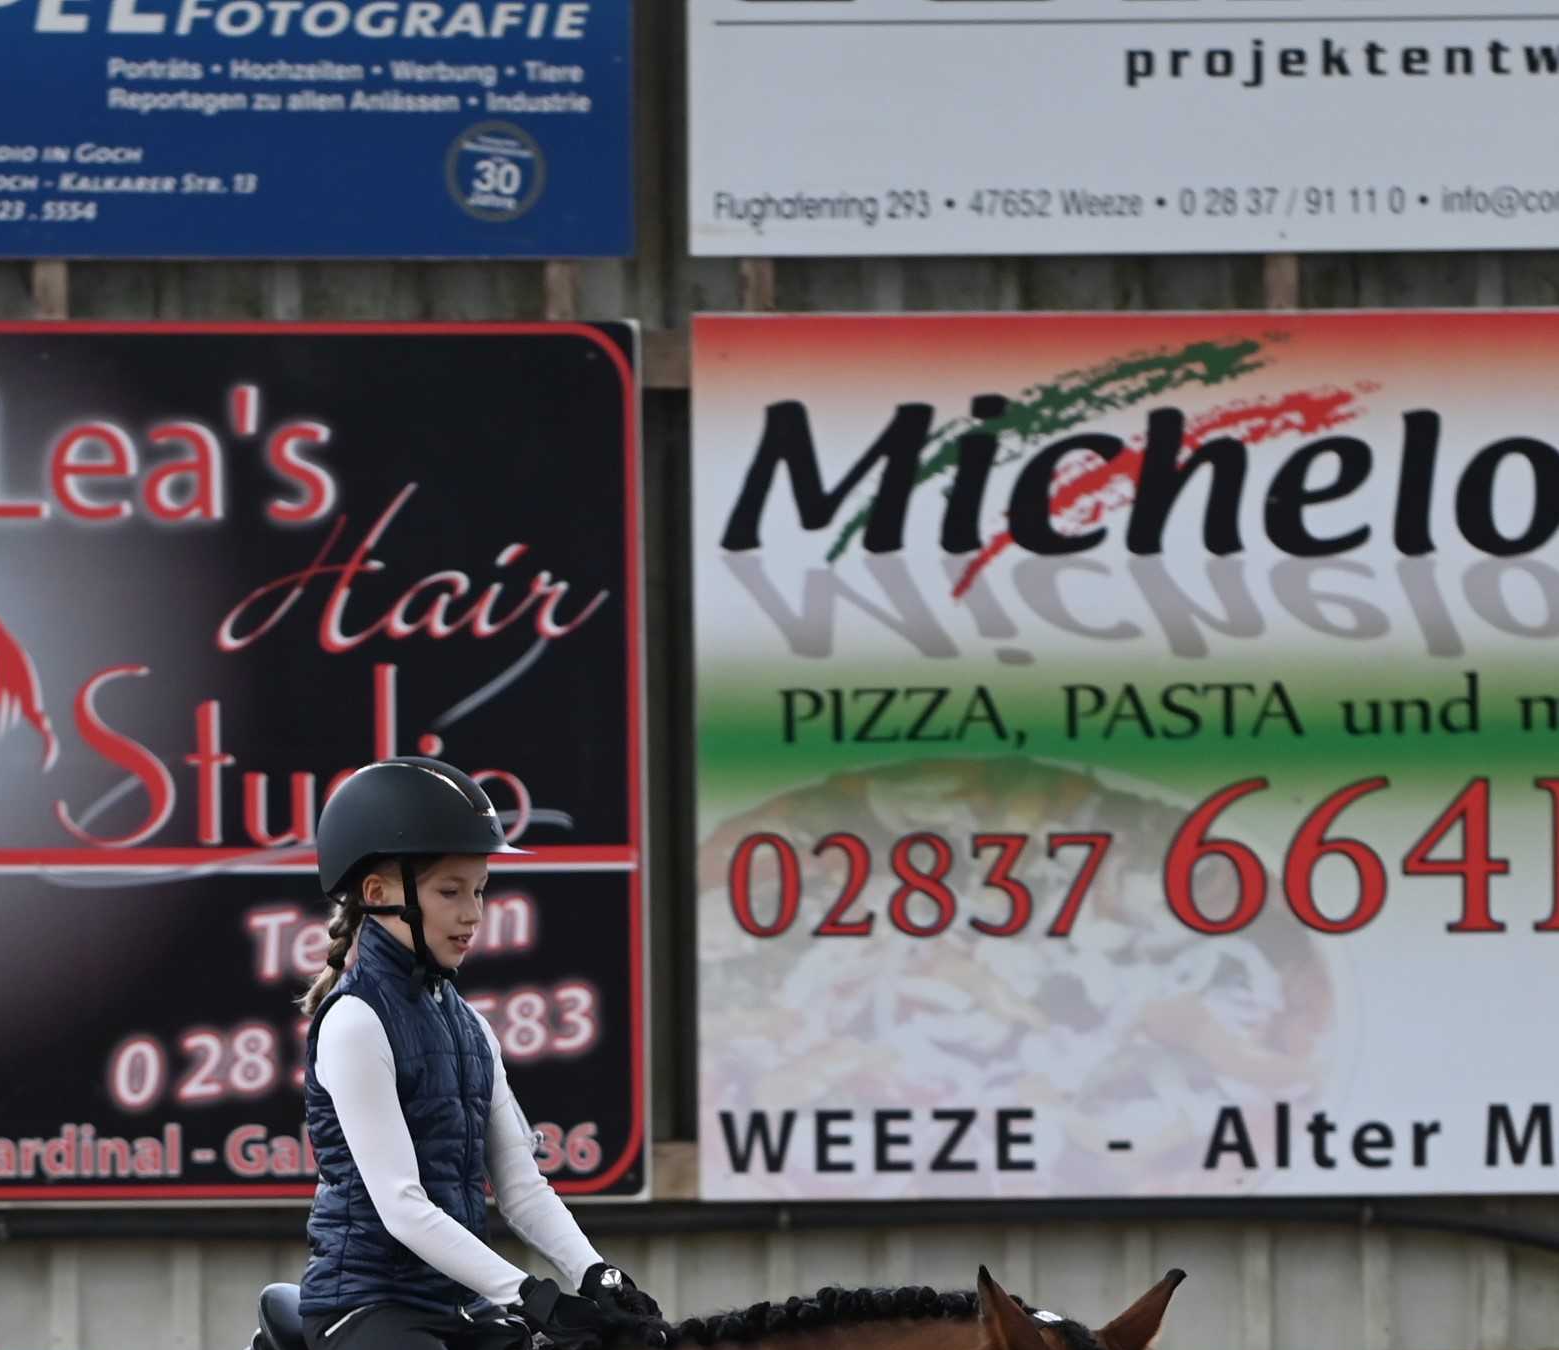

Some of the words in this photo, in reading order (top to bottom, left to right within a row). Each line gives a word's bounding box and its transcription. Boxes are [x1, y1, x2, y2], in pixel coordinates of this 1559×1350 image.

[175, 0, 590, 38] FOTOGRAFIE
[107, 58, 204, 82] Porträts
[230, 60, 364, 83] Hochzeiten
[390, 61, 497, 87] Werbung
[525, 61, 584, 83] Tiere
[107, 89, 248, 115] Reportagen
[252, 95, 282, 112] zu
[288, 91, 345, 112] allen
[350, 92, 460, 113] Anlässen
[487, 93, 591, 114] Industrie
[472, 159, 522, 195] 30
[885, 190, 932, 220] 293
[967, 189, 1052, 218] 47652
[1059, 189, 1144, 217] Weeze
[1178, 186, 1197, 216] 0
[1204, 186, 1238, 216] 28
[1245, 186, 1280, 216] 37
[1304, 186, 1337, 215] 91
[1349, 187, 1378, 215] 11
[1387, 186, 1406, 215] 0
[1441, 184, 1559, 219] info@co
[41, 202, 98, 221] 5554
[719, 394, 1559, 558] Michelo
[215, 482, 609, 655] Hair
[779, 686, 1030, 750] PIZZA,
[1061, 681, 1305, 742] PASTA
[1340, 671, 1482, 736] und
[56, 663, 531, 850] Stuo
[727, 831, 1113, 939] 02837
[113, 1038, 162, 1106] 0
[719, 1108, 1037, 1174] WEEZE
[1203, 1101, 1442, 1171] Alter
